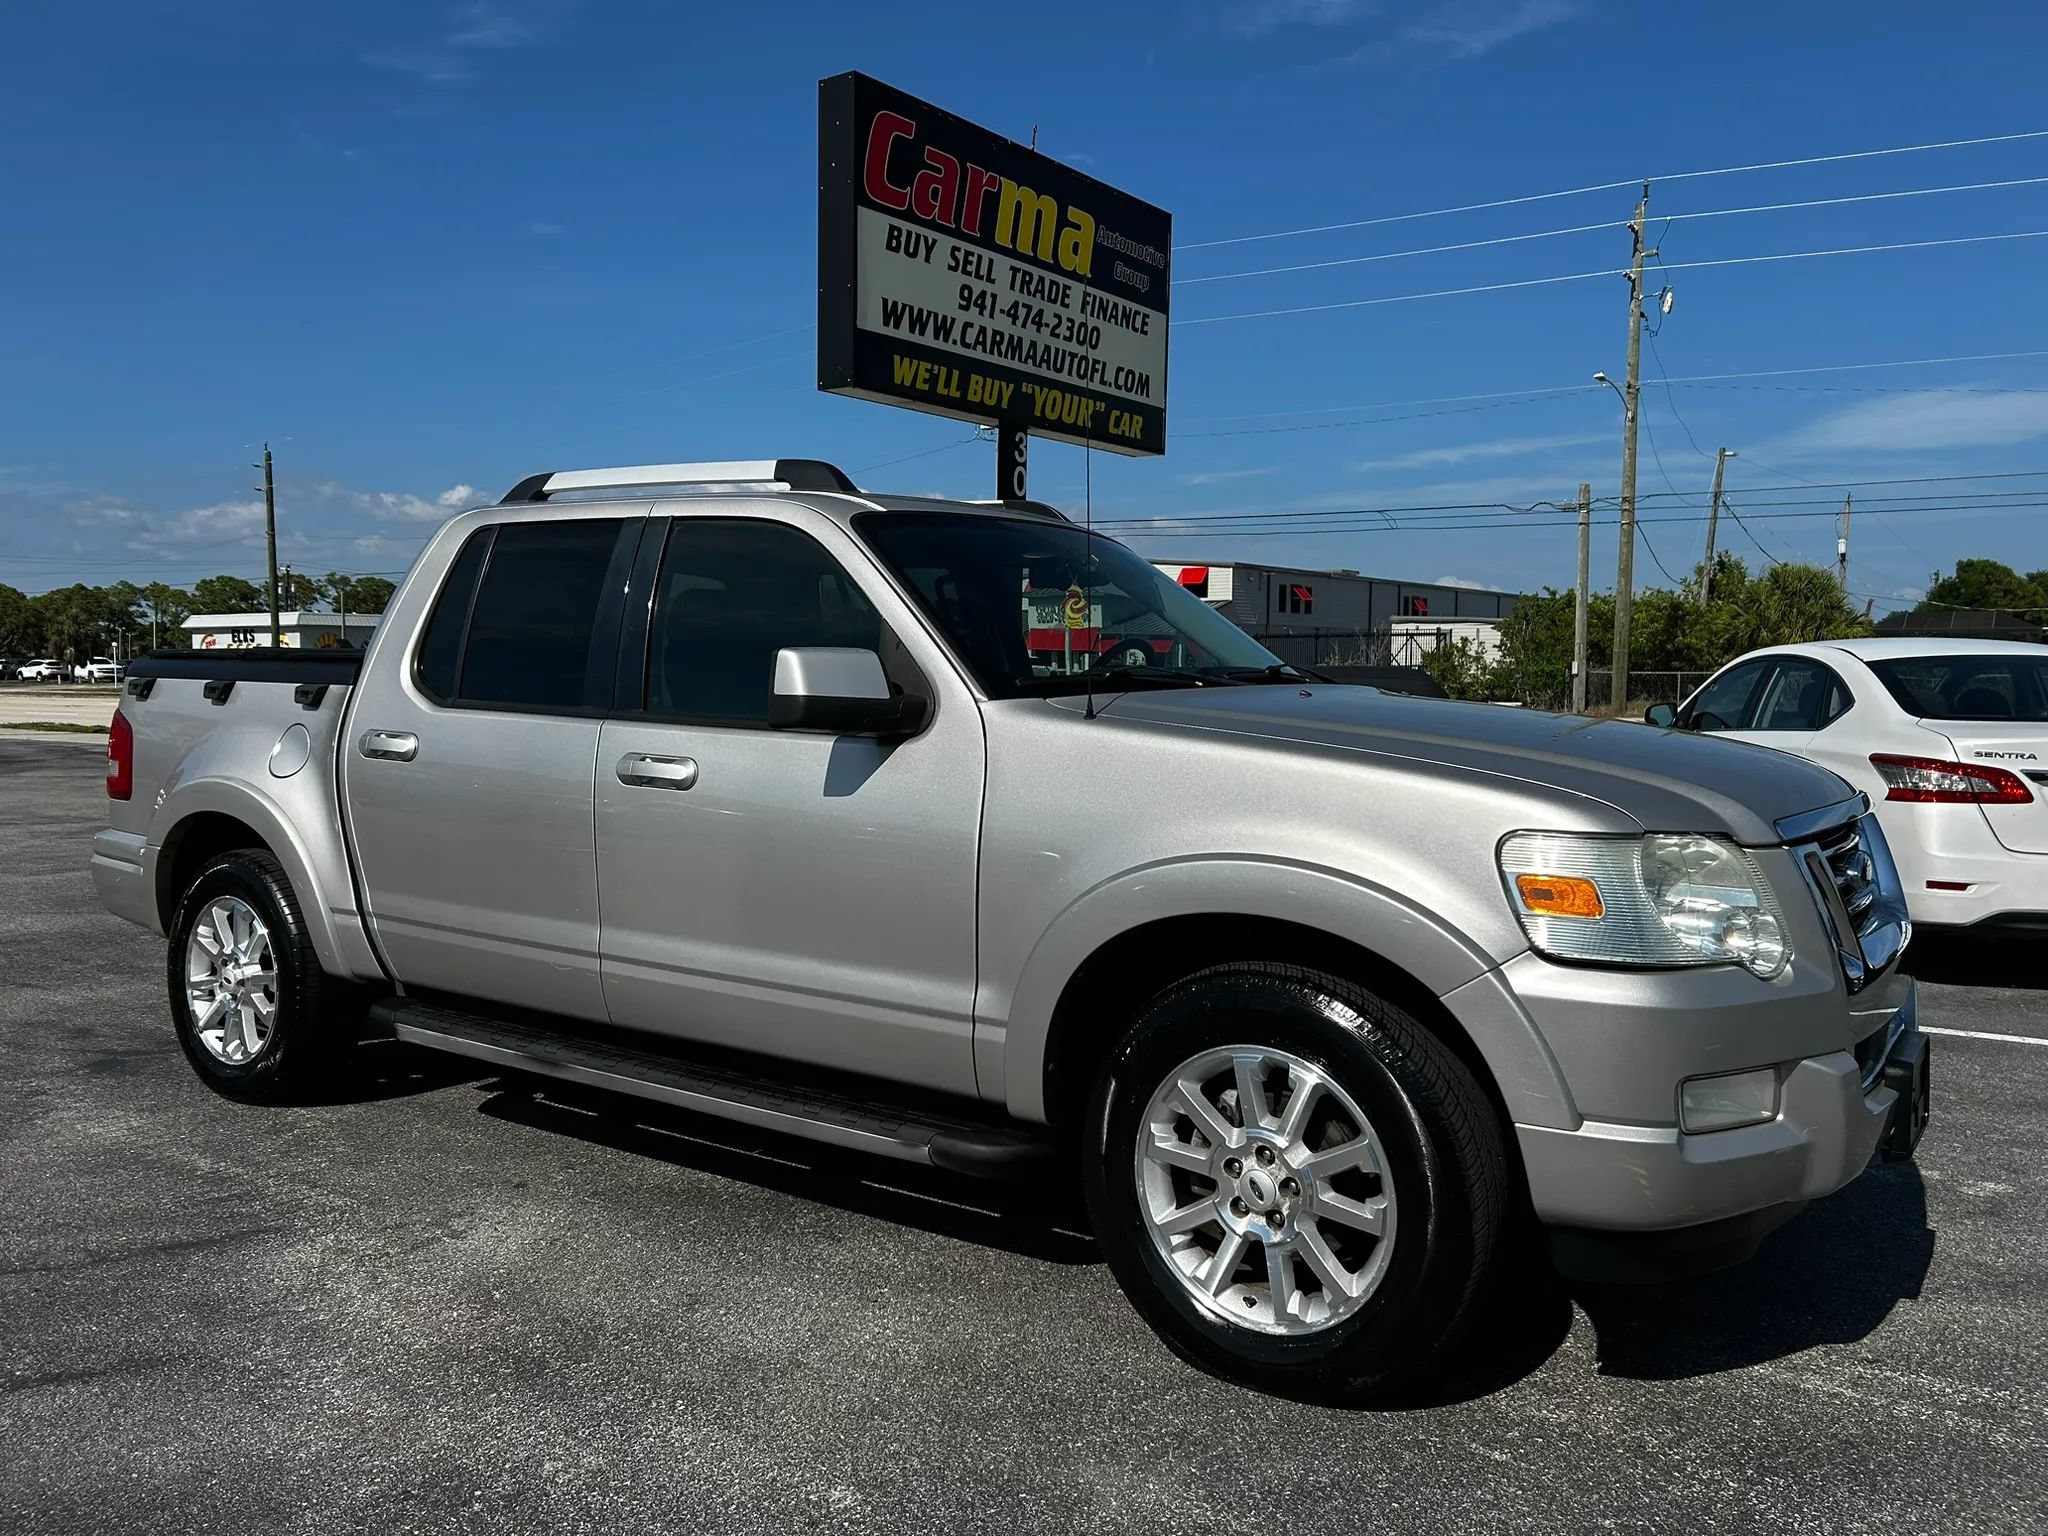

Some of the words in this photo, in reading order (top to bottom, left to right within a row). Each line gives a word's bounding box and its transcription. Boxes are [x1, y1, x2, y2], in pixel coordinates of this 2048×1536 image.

[864, 110, 1095, 278] Carma
[885, 223, 938, 264] BUY
[947, 245, 997, 284] SELL
[1009, 265, 1072, 309] TRADE
[1080, 288, 1150, 336] FINANCE
[1097, 225, 1165, 268] Automotive
[1113, 261, 1150, 292] Group
[881, 296, 1151, 398] WWW.CARMAAUTOFL.COM
[958, 284, 1101, 350] 941-474-2300
[893, 354, 961, 398] WE'LL
[967, 373, 1014, 409] BUY
[1021, 382, 1106, 428] "YOUR"
[1108, 409, 1144, 440] CAR
[1974, 751, 2038, 761] SENTRA
